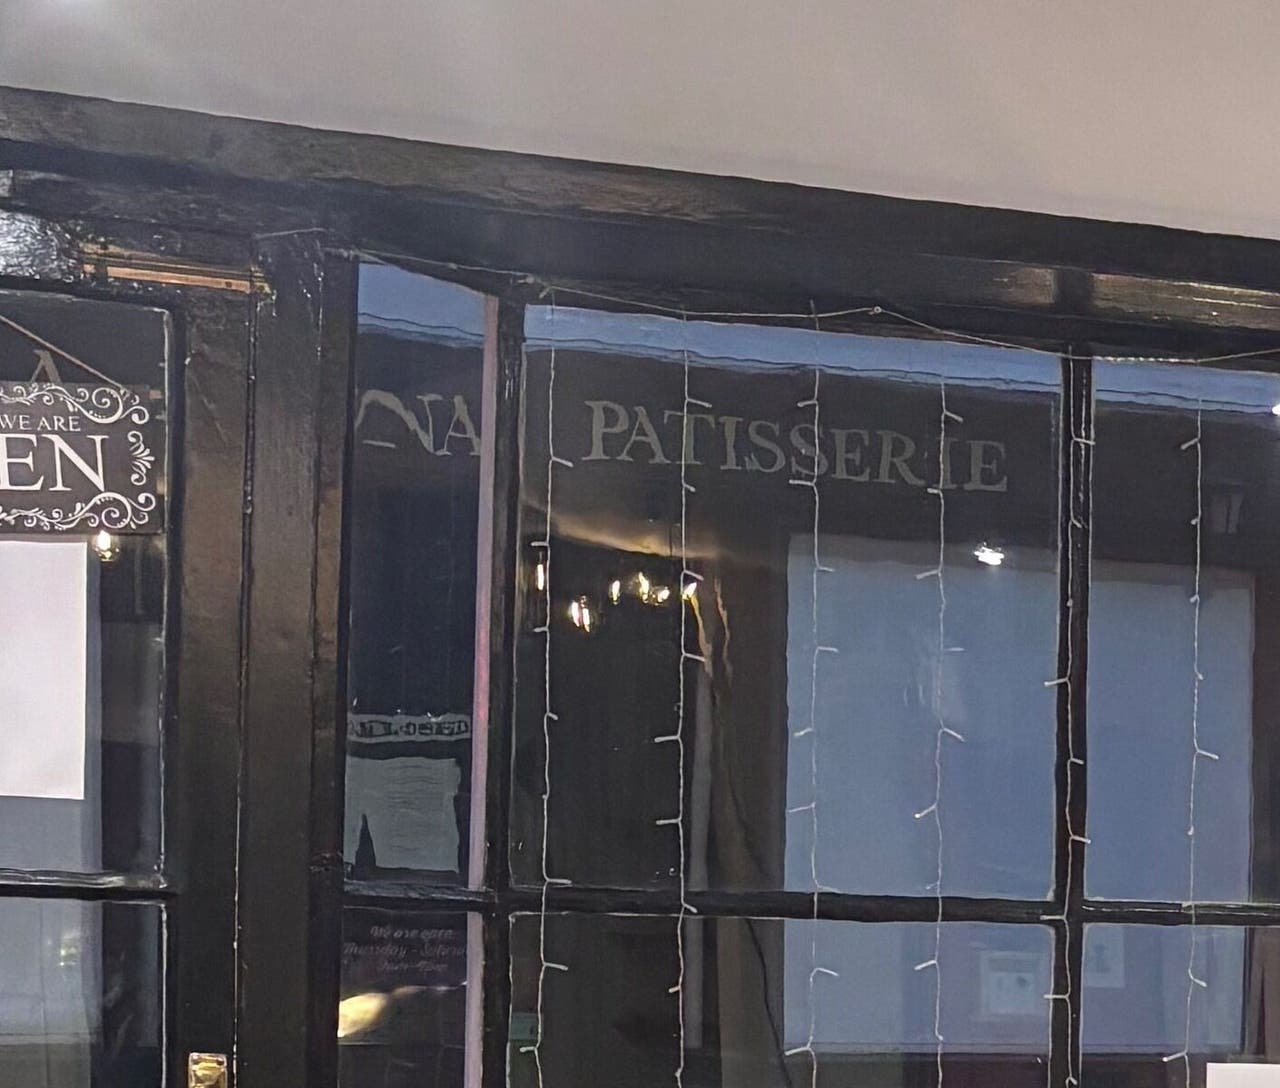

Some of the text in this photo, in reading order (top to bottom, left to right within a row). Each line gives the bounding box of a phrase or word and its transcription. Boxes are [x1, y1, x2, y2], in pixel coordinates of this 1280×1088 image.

[0, 414, 81, 432] WE ARE
[581, 400, 1008, 492] PATISSERIE
[0, 432, 109, 492] EN
